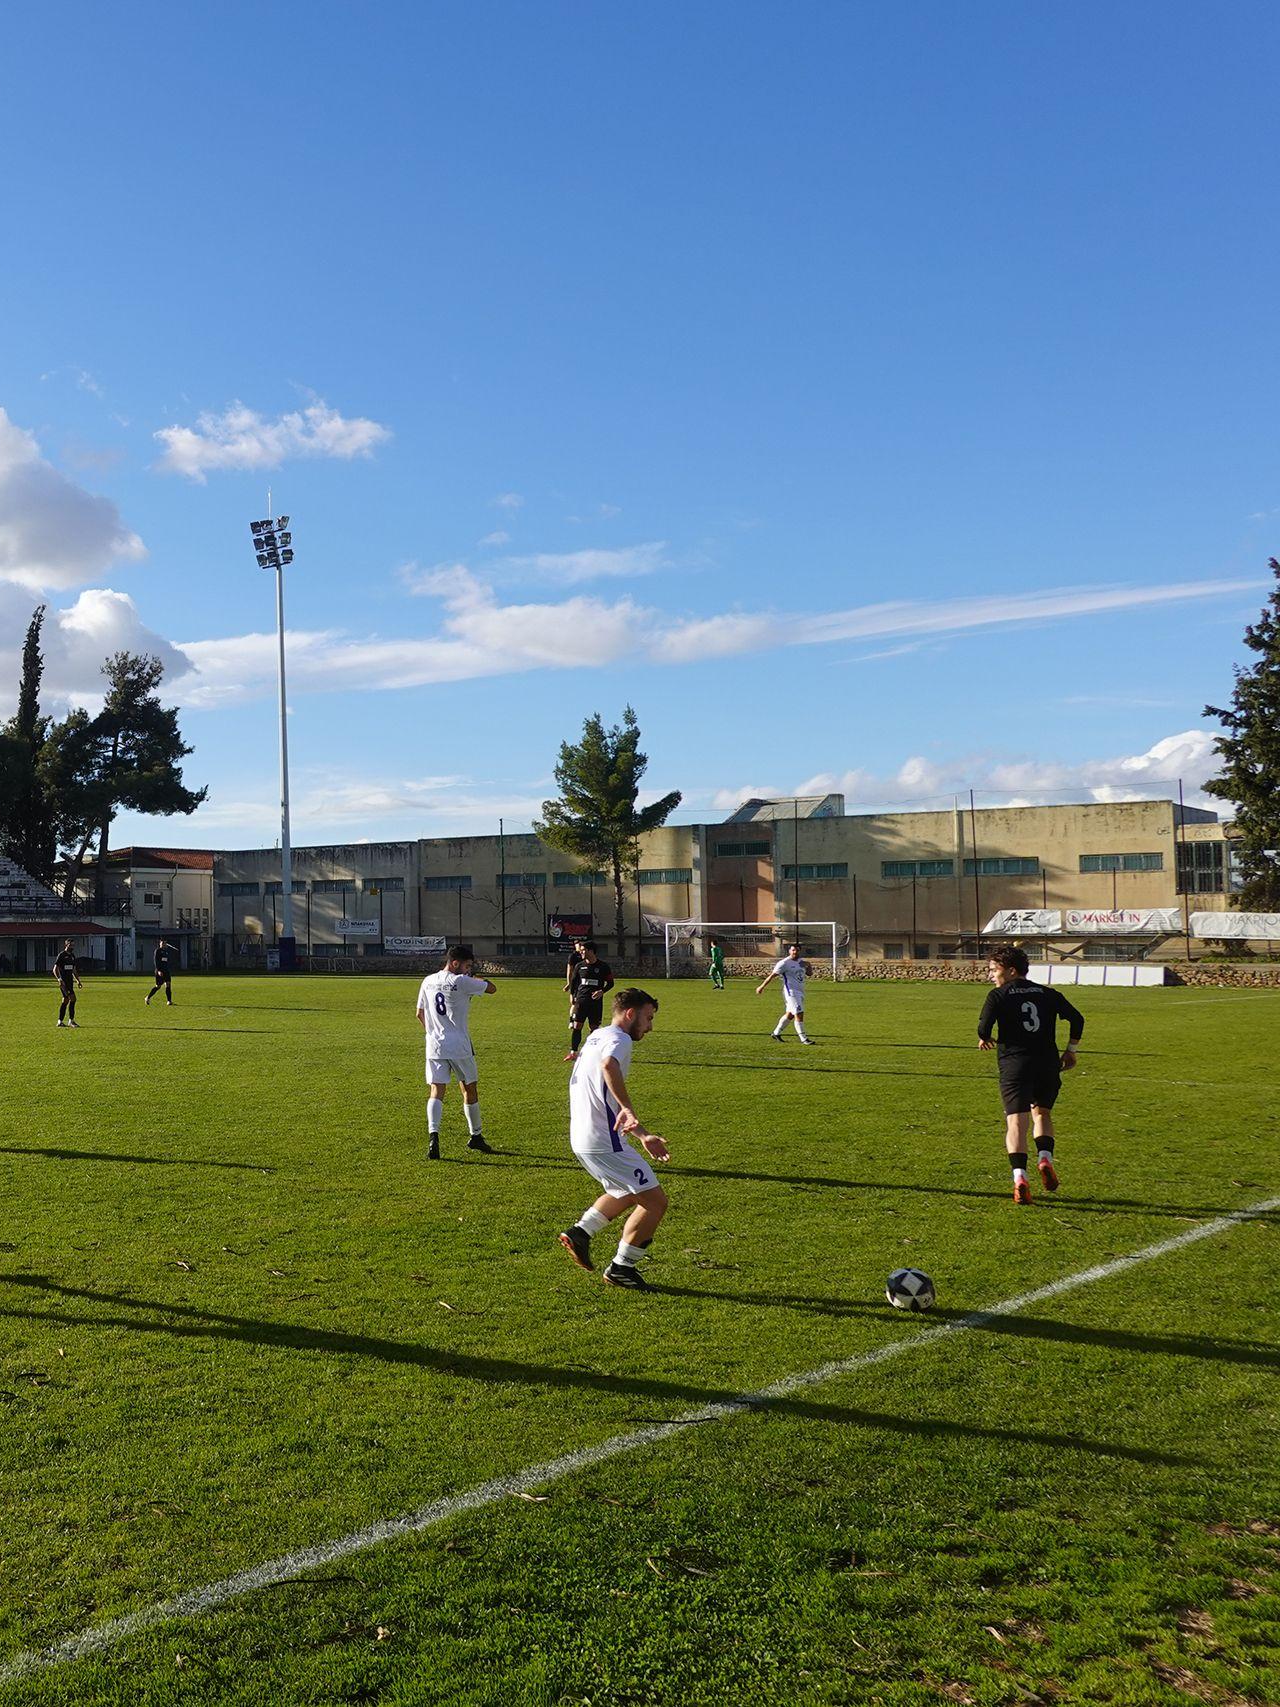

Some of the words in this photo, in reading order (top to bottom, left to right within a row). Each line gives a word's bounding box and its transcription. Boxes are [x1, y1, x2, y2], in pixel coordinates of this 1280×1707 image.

[1084, 913, 1124, 923] MARKET
[1129, 914, 1140, 922] IN
[435, 992, 446, 1016] 8
[1021, 1001, 1040, 1032] 3
[634, 1168, 649, 1185] 2
